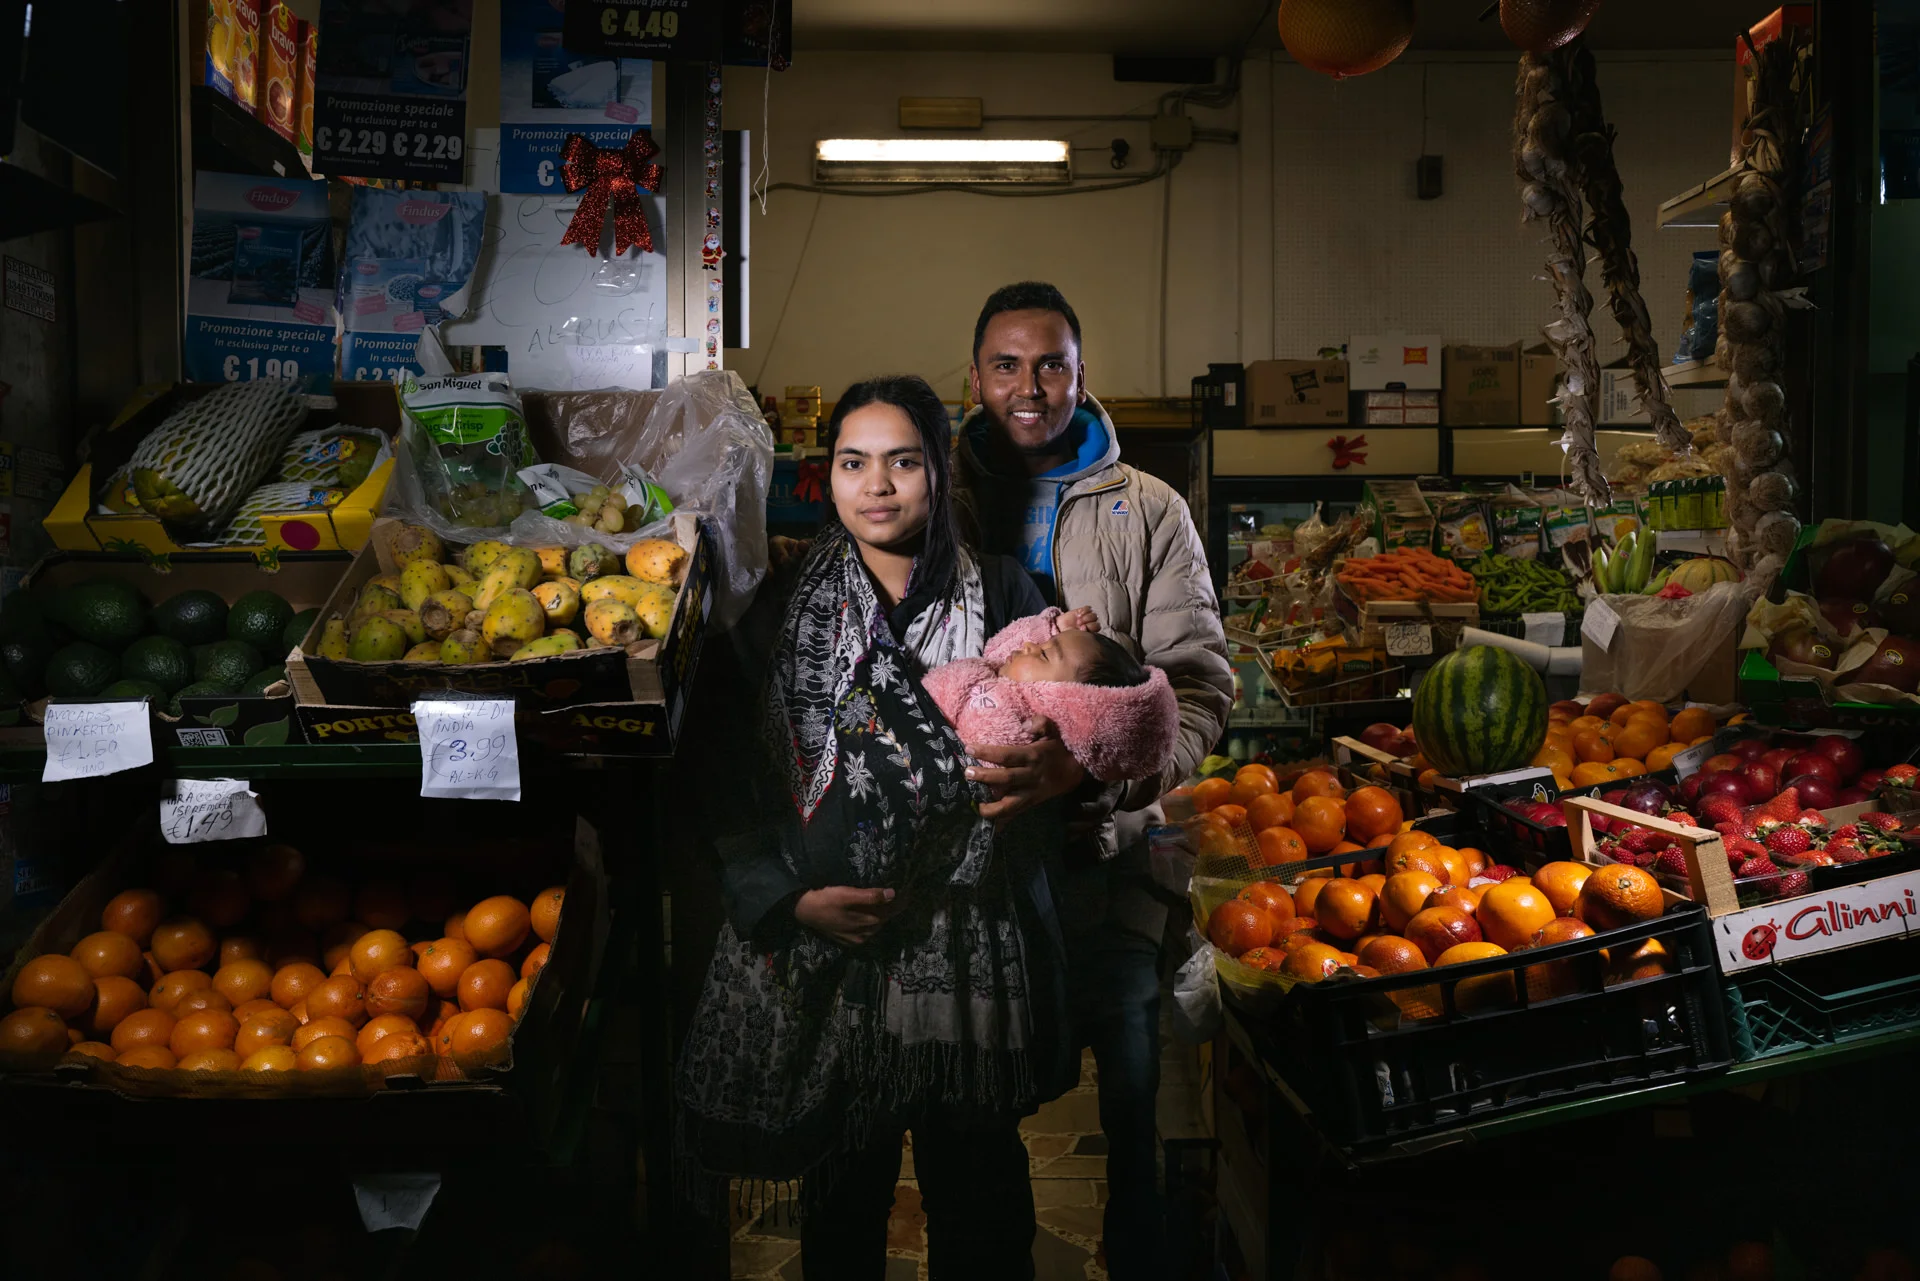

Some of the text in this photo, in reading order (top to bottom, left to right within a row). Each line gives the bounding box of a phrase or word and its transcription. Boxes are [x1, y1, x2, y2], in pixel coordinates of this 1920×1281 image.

[601, 8, 679, 39] € 4,49
[272, 17, 295, 56] bravo
[327, 97, 455, 117] Promozione speciale
[342, 113, 352, 123] In
[355, 114, 397, 126] esclusiva
[400, 120, 416, 129] per
[420, 120, 428, 128] te
[317, 126, 462, 160] € 2,29 € 2,29
[590, 128, 634, 145] special
[528, 143, 538, 152] In
[537, 160, 555, 187] €
[251, 191, 289, 205] Findus
[402, 205, 440, 217] Findus
[200, 321, 326, 342] Promozione speciale
[214, 338, 224, 347] In
[227, 339, 269, 350] esclusiva
[272, 344, 288, 353] per
[291, 345, 300, 353] te
[355, 337, 418, 350] Promozion
[370, 353, 417, 363] In esclusiv
[223, 355, 299, 382] € 199
[419, 378, 481, 390] san Miguel
[425, 422, 452, 432] ugar
[47, 722, 126, 741] PINKERTON
[310, 711, 657, 738] PORTO AGGI
[206, 733, 217, 742] 12
[427, 734, 506, 777] €3.99
[167, 810, 233, 839] €1.49
